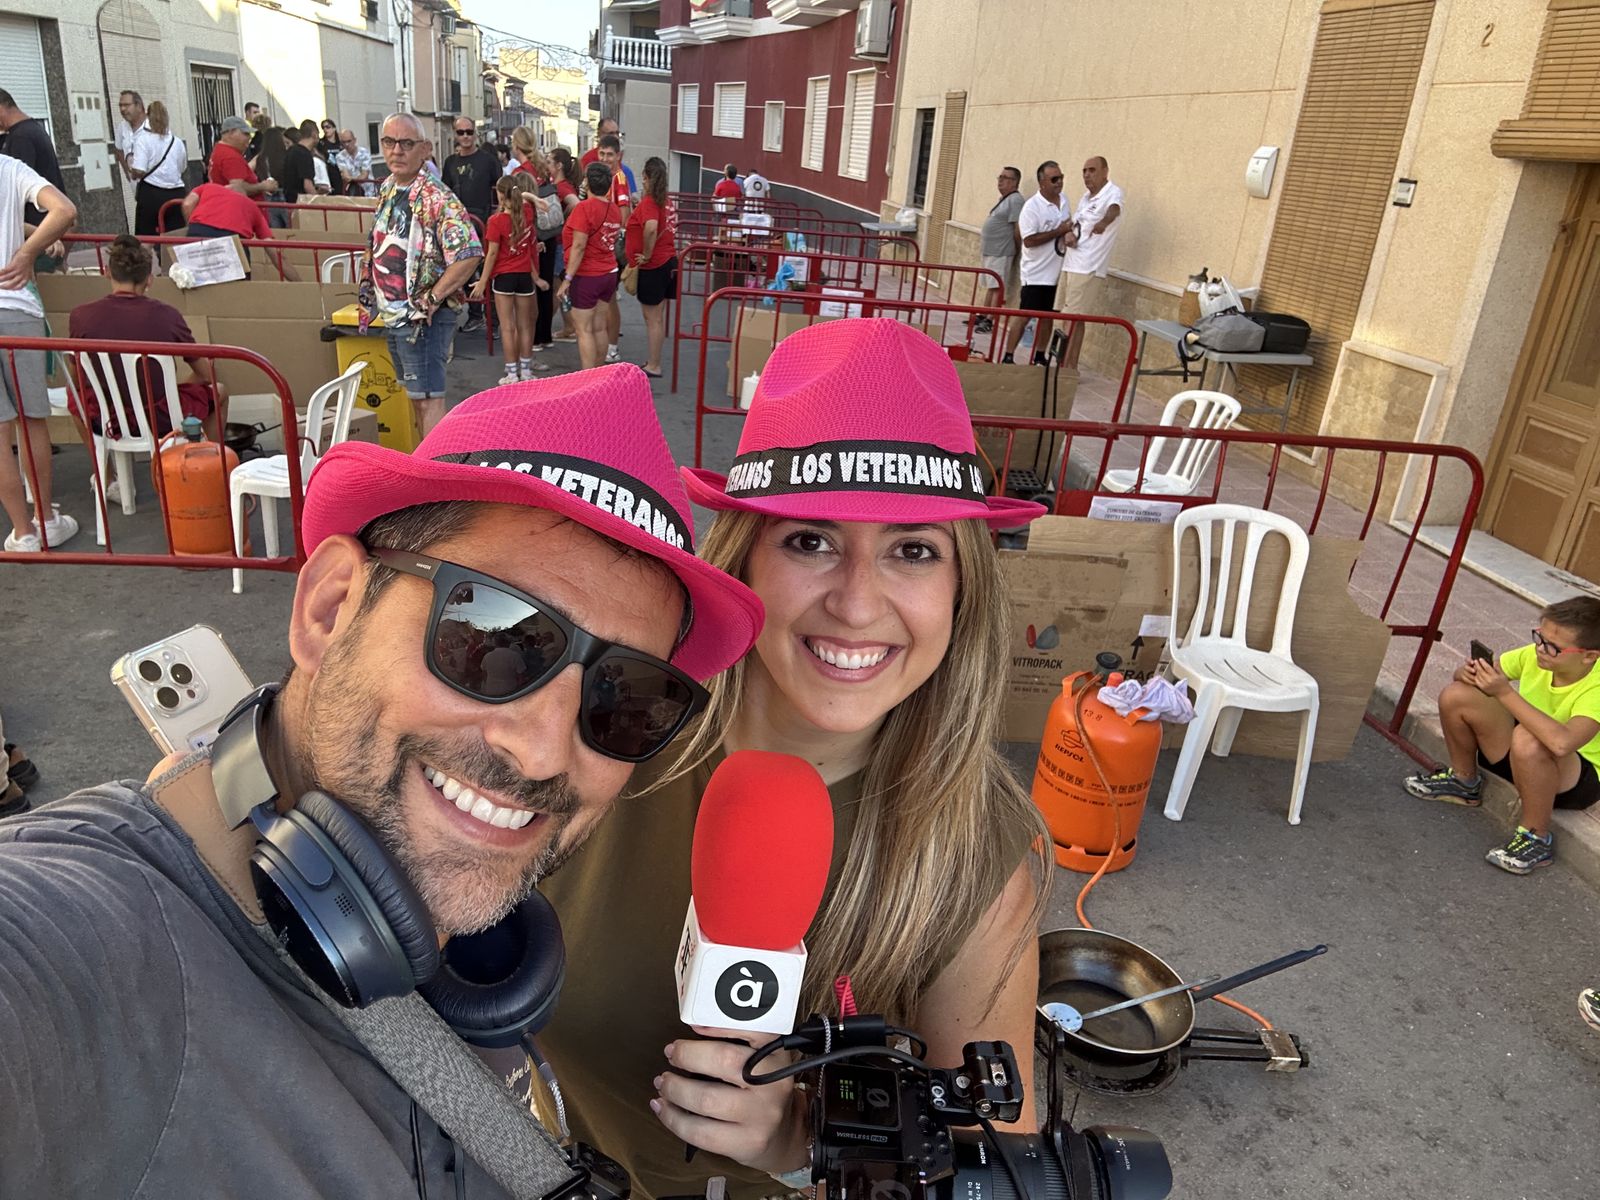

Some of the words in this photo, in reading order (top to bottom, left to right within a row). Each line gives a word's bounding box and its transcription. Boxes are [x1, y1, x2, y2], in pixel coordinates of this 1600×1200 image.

[1480, 22, 1496, 48] 2
[790, 453, 832, 485] LOS
[839, 451, 963, 491] VETERANOS
[1013, 656, 1063, 670] VITROPACK
[1055, 743, 1085, 764] REPSOL
[836, 1131, 870, 1141] WIRELESS
[977, 1141, 987, 1165] TAMRON
